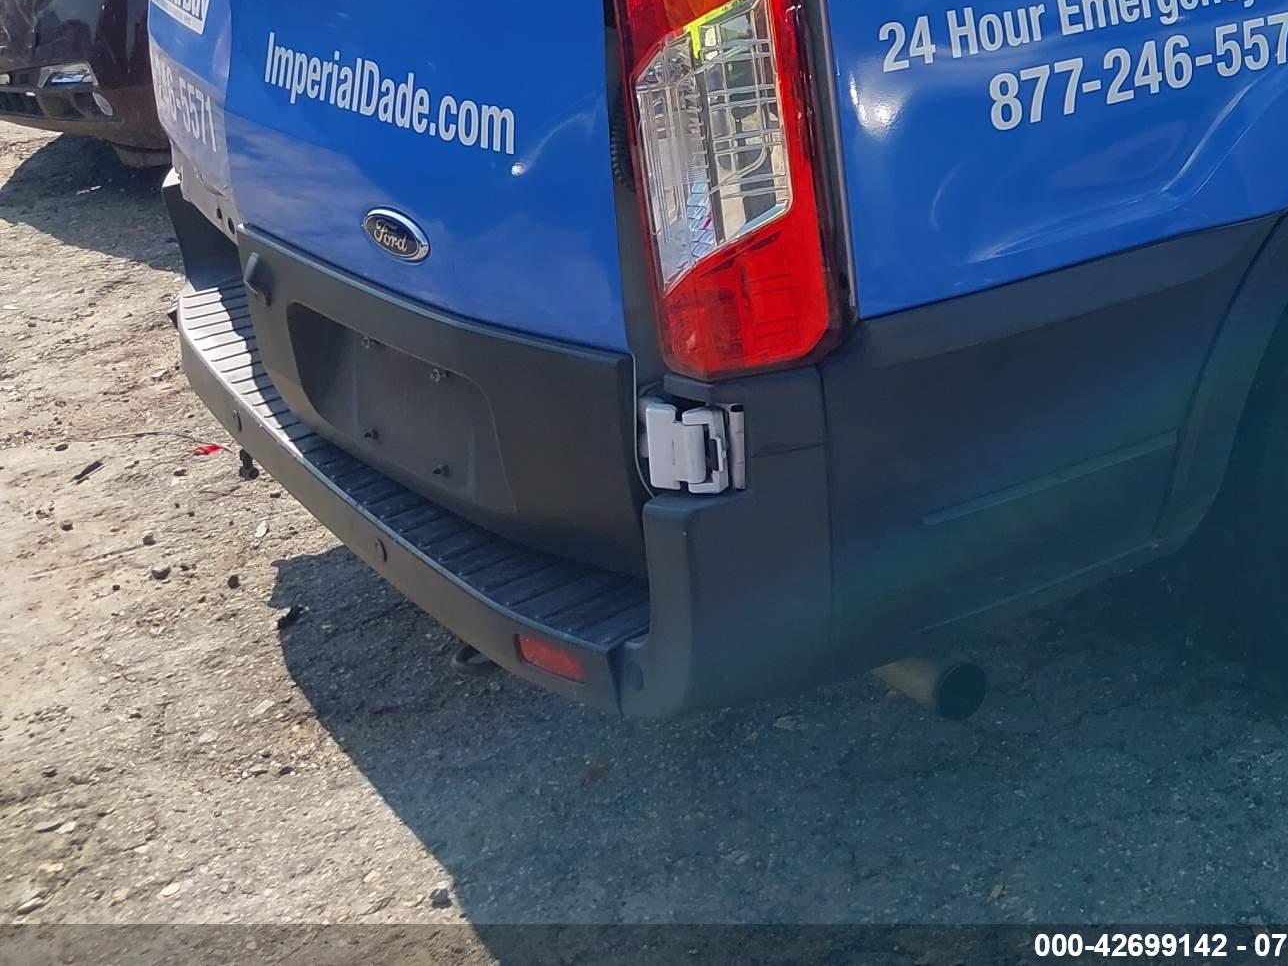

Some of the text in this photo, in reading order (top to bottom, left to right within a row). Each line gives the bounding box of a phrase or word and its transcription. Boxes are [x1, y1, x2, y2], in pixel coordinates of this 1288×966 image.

[878, 14, 936, 73] 24
[946, 3, 1046, 59] Hour
[264, 32, 515, 155] ImperialDade.com
